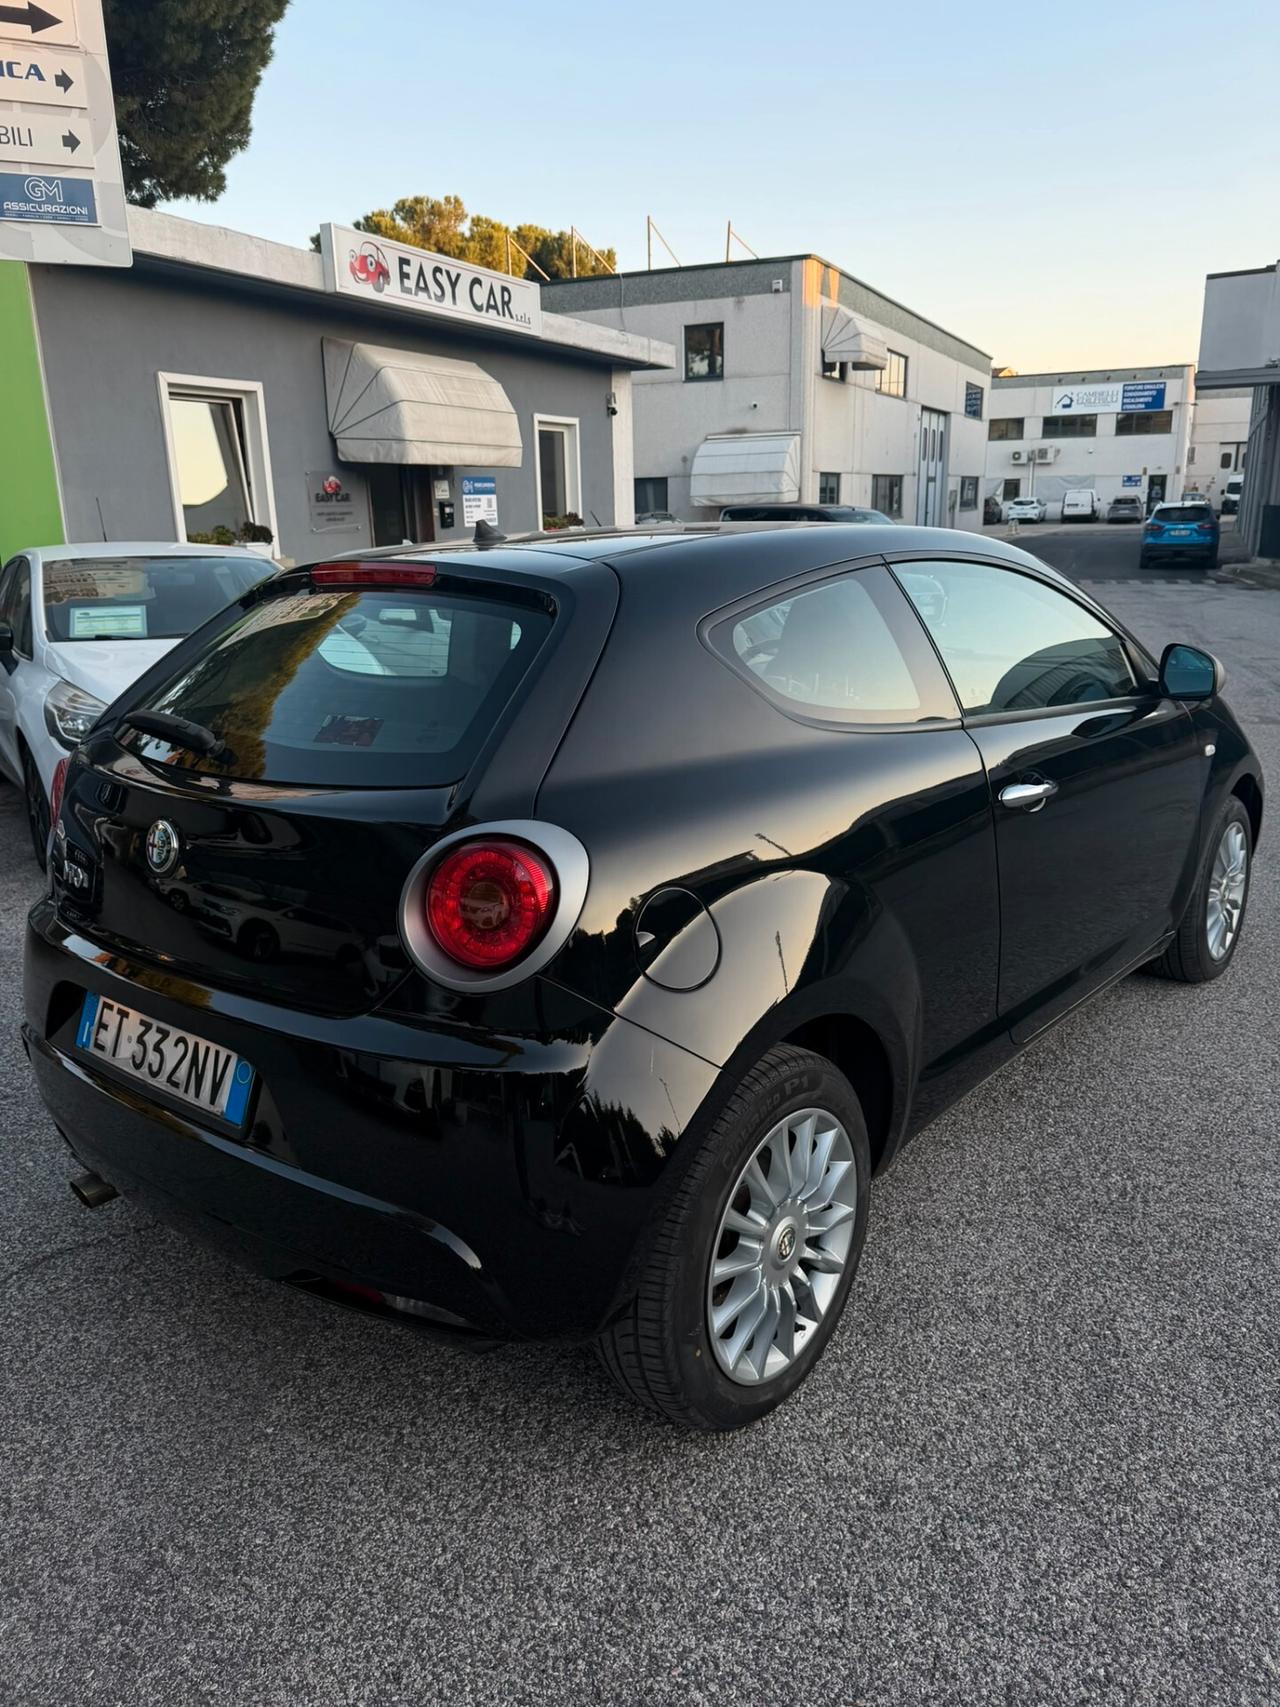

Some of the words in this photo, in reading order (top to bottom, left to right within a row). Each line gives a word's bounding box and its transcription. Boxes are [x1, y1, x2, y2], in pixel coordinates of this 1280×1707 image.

[0, 125, 33, 147] BILI
[24, 177, 63, 202] GM
[3, 202, 88, 215] ASSICURAZIONI
[397, 256, 461, 305] EASY
[468, 277, 513, 318] CAR
